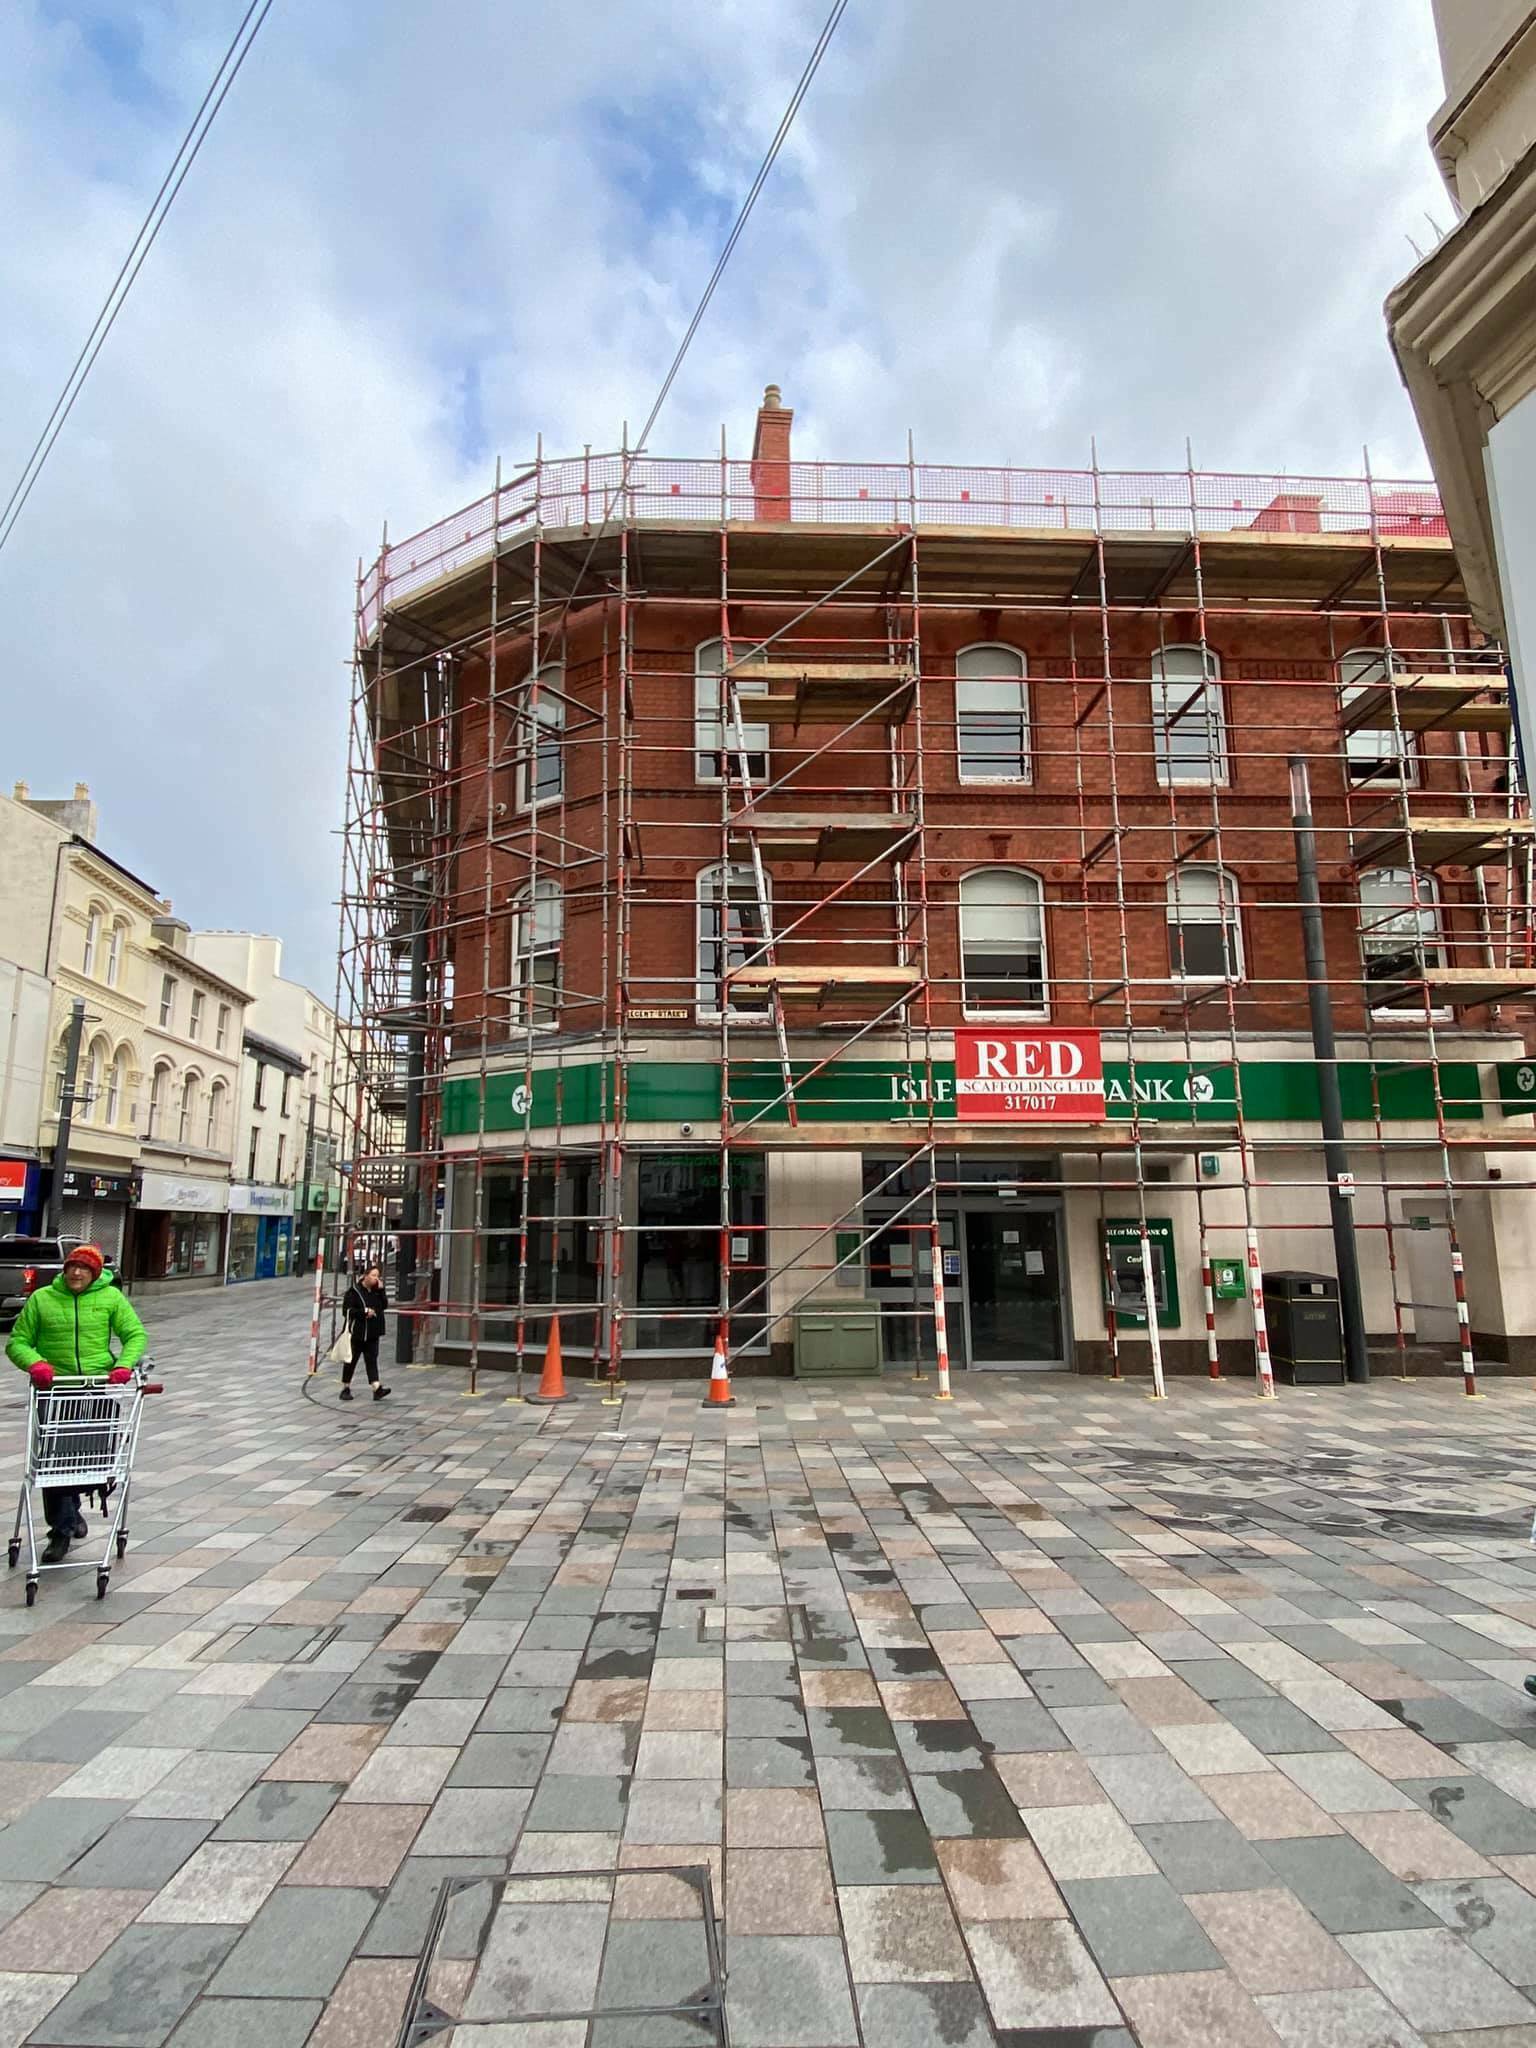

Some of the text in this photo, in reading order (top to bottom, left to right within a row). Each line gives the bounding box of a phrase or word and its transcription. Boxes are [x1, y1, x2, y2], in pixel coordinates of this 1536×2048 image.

[974, 1040, 1084, 1078] RED
[963, 1080, 1096, 1093] SCAFFOLDING LTD
[1103, 1078, 1174, 1103] ANK
[1004, 1095, 1057, 1111] 317017
